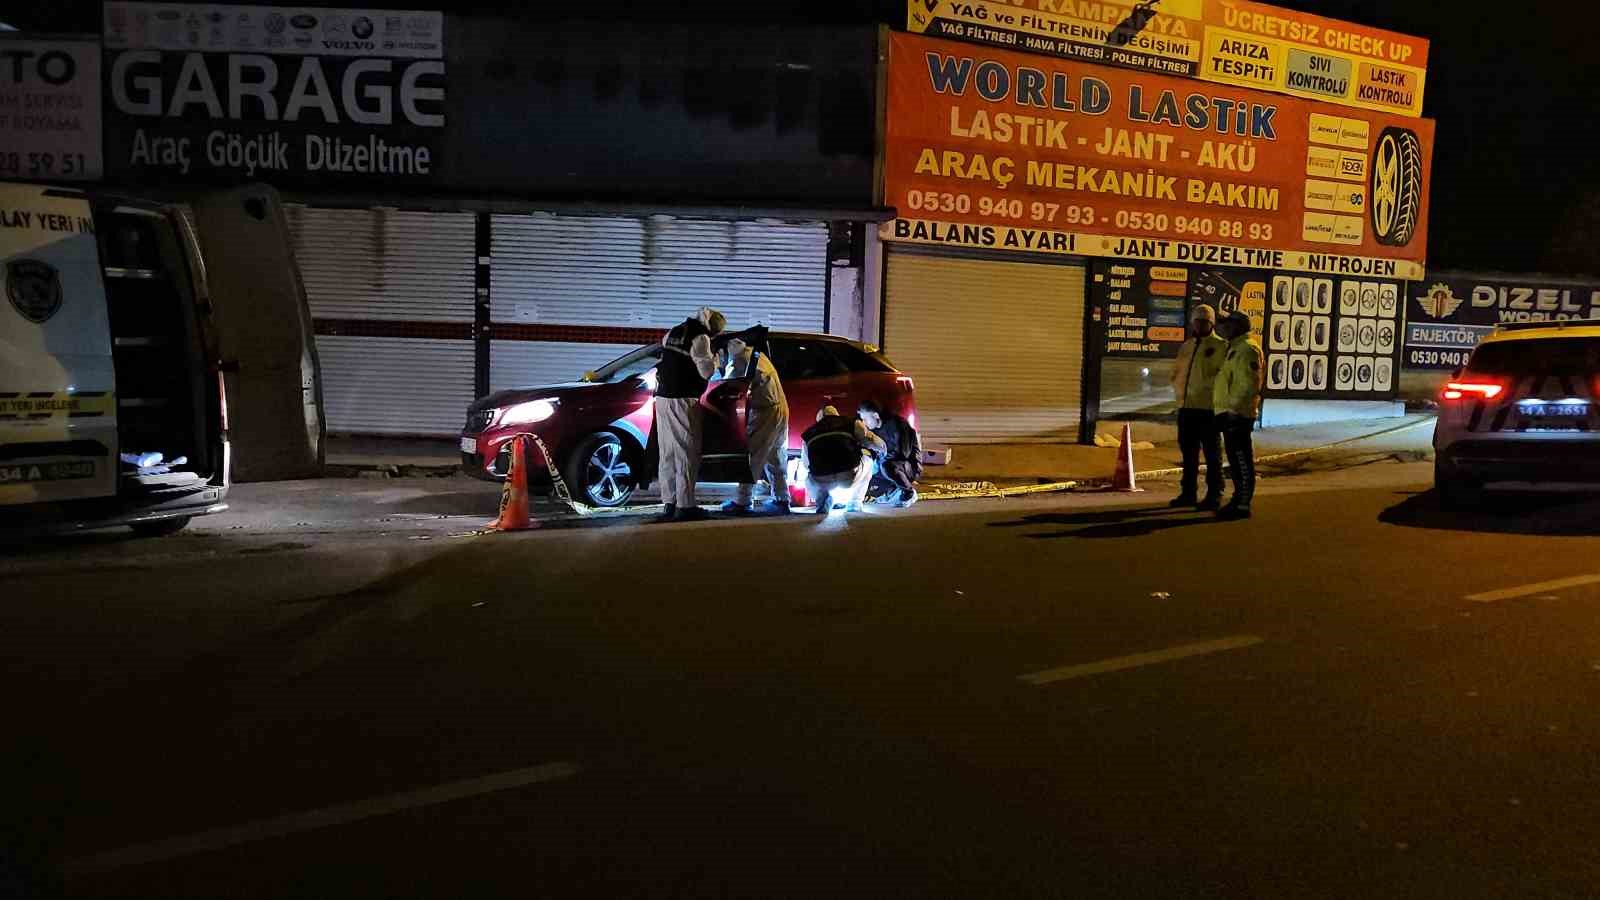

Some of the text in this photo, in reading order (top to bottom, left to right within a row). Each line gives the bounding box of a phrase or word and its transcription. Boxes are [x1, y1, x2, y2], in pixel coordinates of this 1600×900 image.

[950, 2, 988, 20] YAĞ
[994, 13, 1015, 25] ve
[1020, 15, 1112, 43] FİLTRENİN
[321, 40, 374, 50] VOLVO
[940, 22, 965, 36] YAĞ
[967, 26, 1017, 45] FİLTRESİ
[1026, 38, 1055, 51] HAVA
[1058, 42, 1104, 60] FİLTRESİ
[1112, 52, 1145, 67] POLEN
[1147, 56, 1190, 75] FİLTRESİ
[1220, 38, 1269, 61] ARIZA
[1324, 29, 1385, 57] CHECK
[1389, 43, 1412, 62] UP
[1309, 56, 1331, 73] SIVI
[111, 50, 445, 127] GARAGE
[926, 52, 1112, 115] WORLD
[130, 128, 431, 176] Araç Göçük Düzeltme
[1096, 127, 1173, 162] JANT
[1197, 140, 1256, 172] AKÜ
[914, 149, 1279, 211] ARAÇ MEKANİK BAKIM
[907, 190, 971, 214] 0530
[978, 197, 1023, 219] 940
[1031, 202, 1060, 224] 97
[1066, 206, 1095, 225] 93
[1115, 210, 1169, 232] 0530
[1175, 216, 1213, 236] 940
[1218, 220, 1243, 239] 88
[1249, 223, 1273, 241] 93
[895, 219, 1075, 251] BALANS AYARI
[1113, 238, 1170, 259] JANT
[1412, 327, 1475, 344] ENJEKTÖR
[1411, 350, 1438, 364] 0530
[1440, 351, 1460, 365] 940
